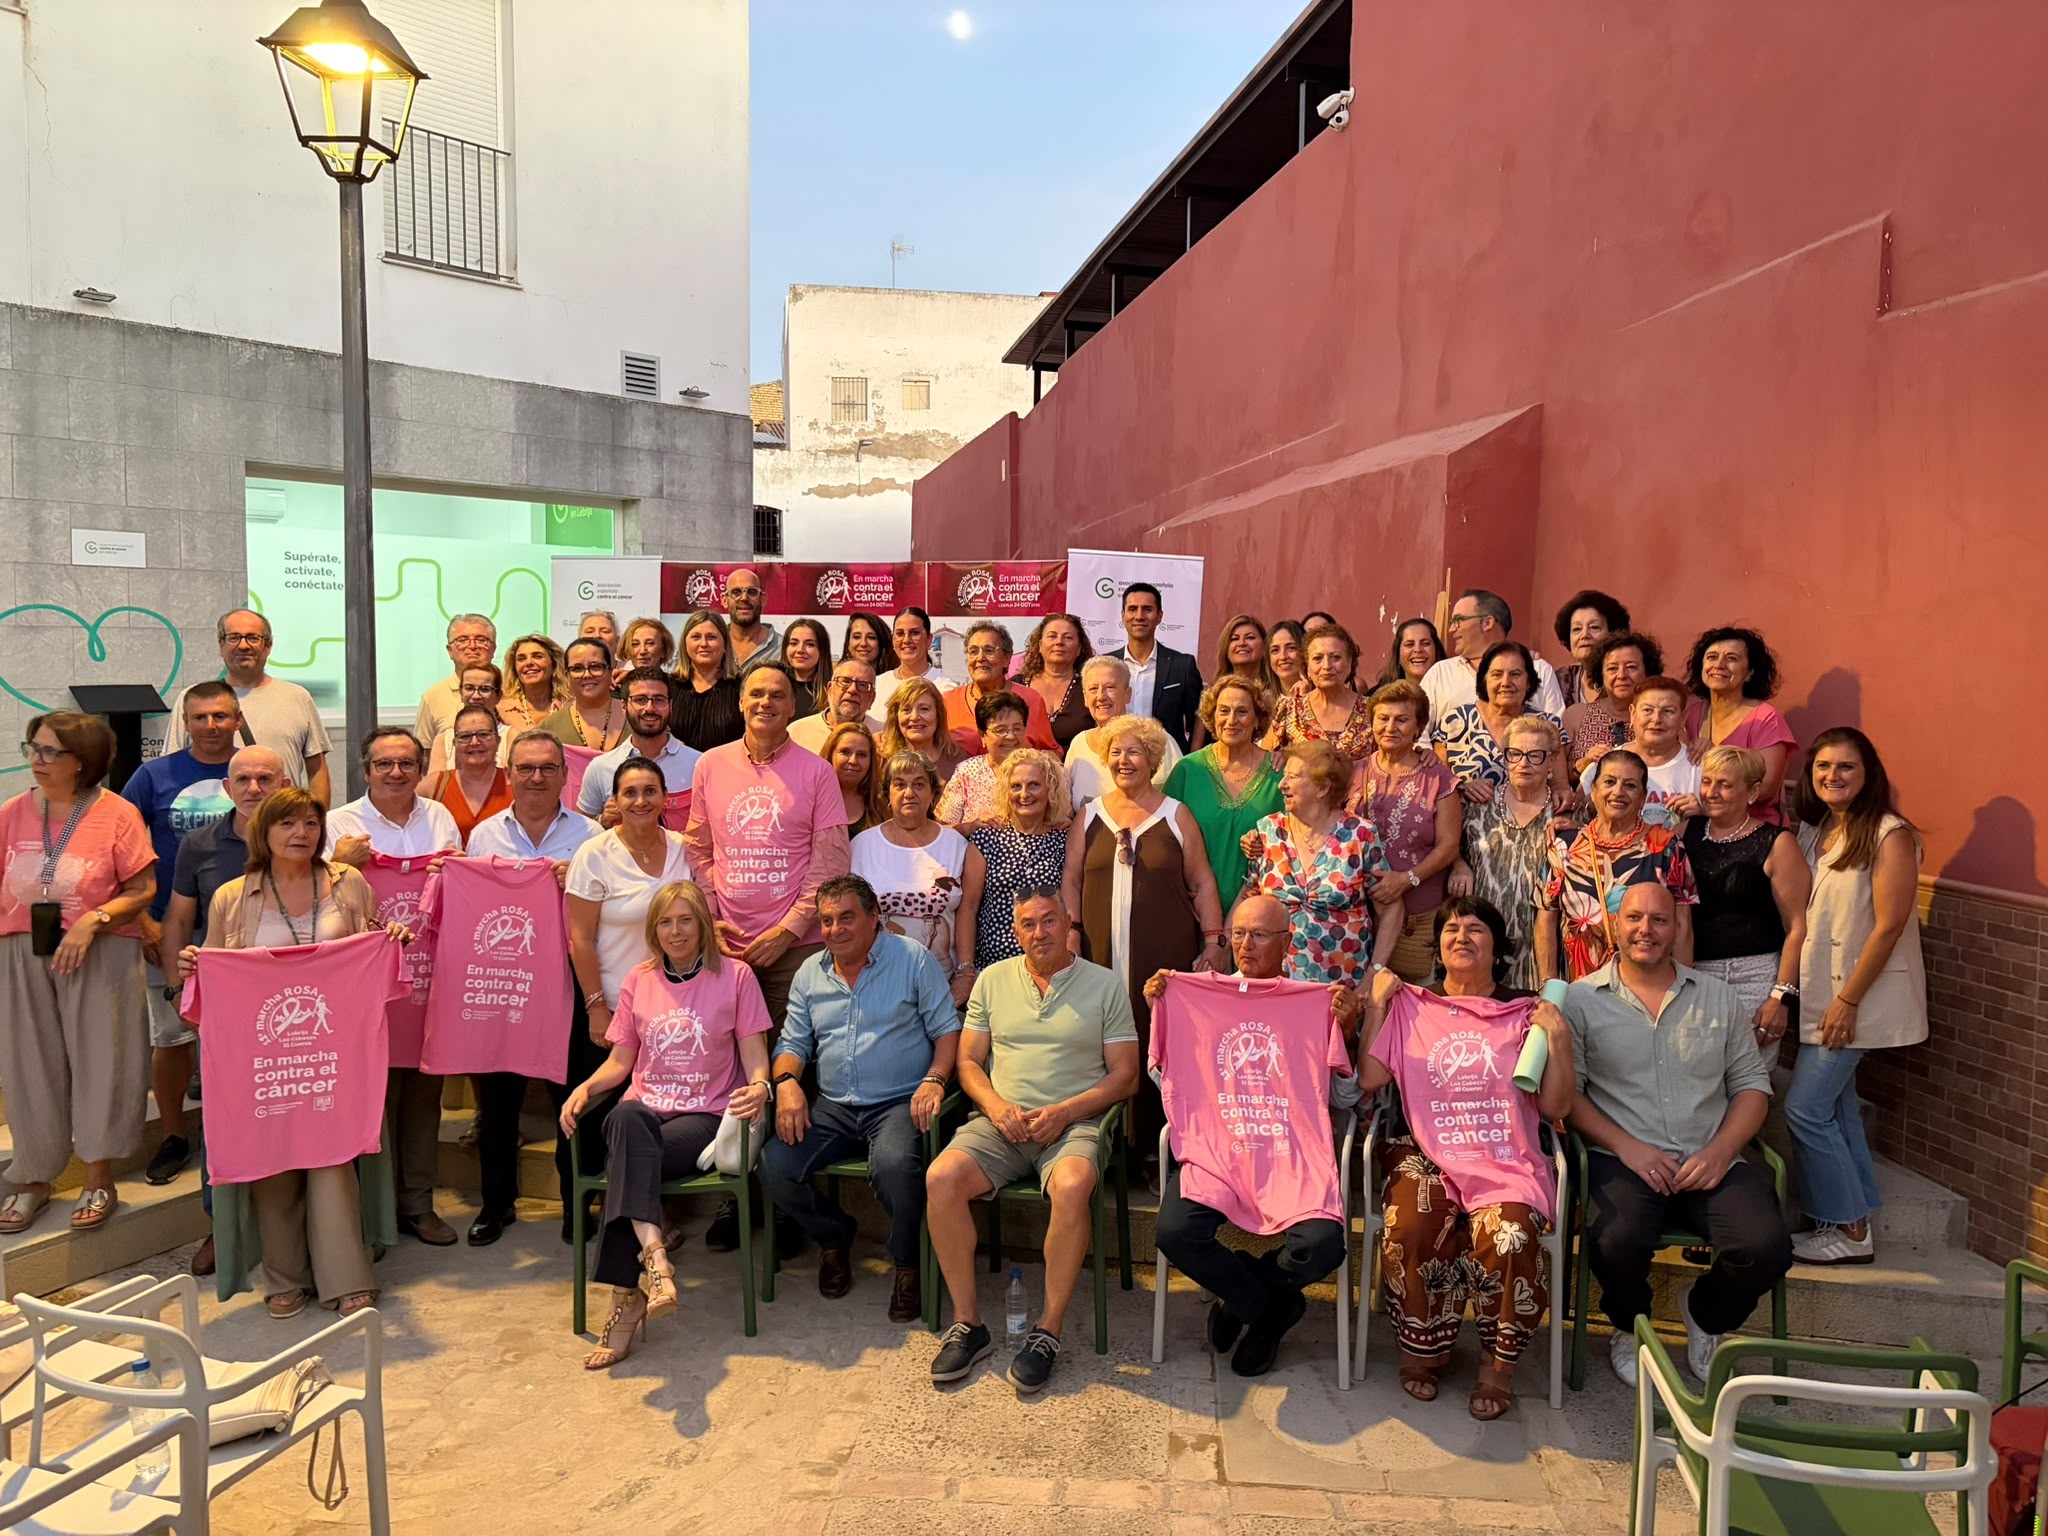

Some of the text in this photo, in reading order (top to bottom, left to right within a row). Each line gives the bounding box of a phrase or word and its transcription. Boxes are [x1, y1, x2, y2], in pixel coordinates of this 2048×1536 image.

[284, 551, 341, 564] Supérate,
[284, 566, 336, 578] actívate,
[828, 570, 844, 578] ROSA
[864, 574, 894, 582] marcha
[971, 569, 990, 578] ROSA
[1010, 574, 1040, 582] marcha
[284, 580, 344, 590] conéctate
[854, 583, 894, 592] contra el
[998, 582, 1040, 592] contra el
[854, 590, 894, 601] cáncer
[998, 590, 1040, 601] cáncer
[726, 791, 748, 822] marcha
[748, 786, 774, 796] ROSA
[725, 846, 789, 856] En marcha
[728, 857, 788, 868] contra el
[726, 868, 788, 884] cáncer
[474, 910, 499, 940] marcha
[500, 906, 529, 918] ROSA
[418, 962, 432, 974] el
[467, 964, 534, 980] En marcha
[465, 978, 530, 994] contra el
[463, 989, 528, 1008] cáncer
[256, 994, 282, 1030] marcha
[284, 986, 318, 998] ROSA
[646, 1014, 666, 1046] marcha
[668, 1007, 696, 1018] ROSA
[1217, 1028, 1238, 1064] marcha
[1240, 1022, 1270, 1034] ROSA
[1427, 1036, 1449, 1072] marcha
[1450, 1030, 1482, 1040] ROSA
[254, 1050, 338, 1069] En marcha
[254, 1061, 338, 1083] contra el
[644, 1071, 710, 1082] En marcha
[254, 1079, 337, 1100] cáncer
[1218, 1092, 1289, 1106] En marcha
[1430, 1096, 1510, 1112] En marcha
[1221, 1106, 1272, 1119] contra
[1434, 1110, 1511, 1128] contra el
[1437, 1126, 1512, 1145] cáncer
